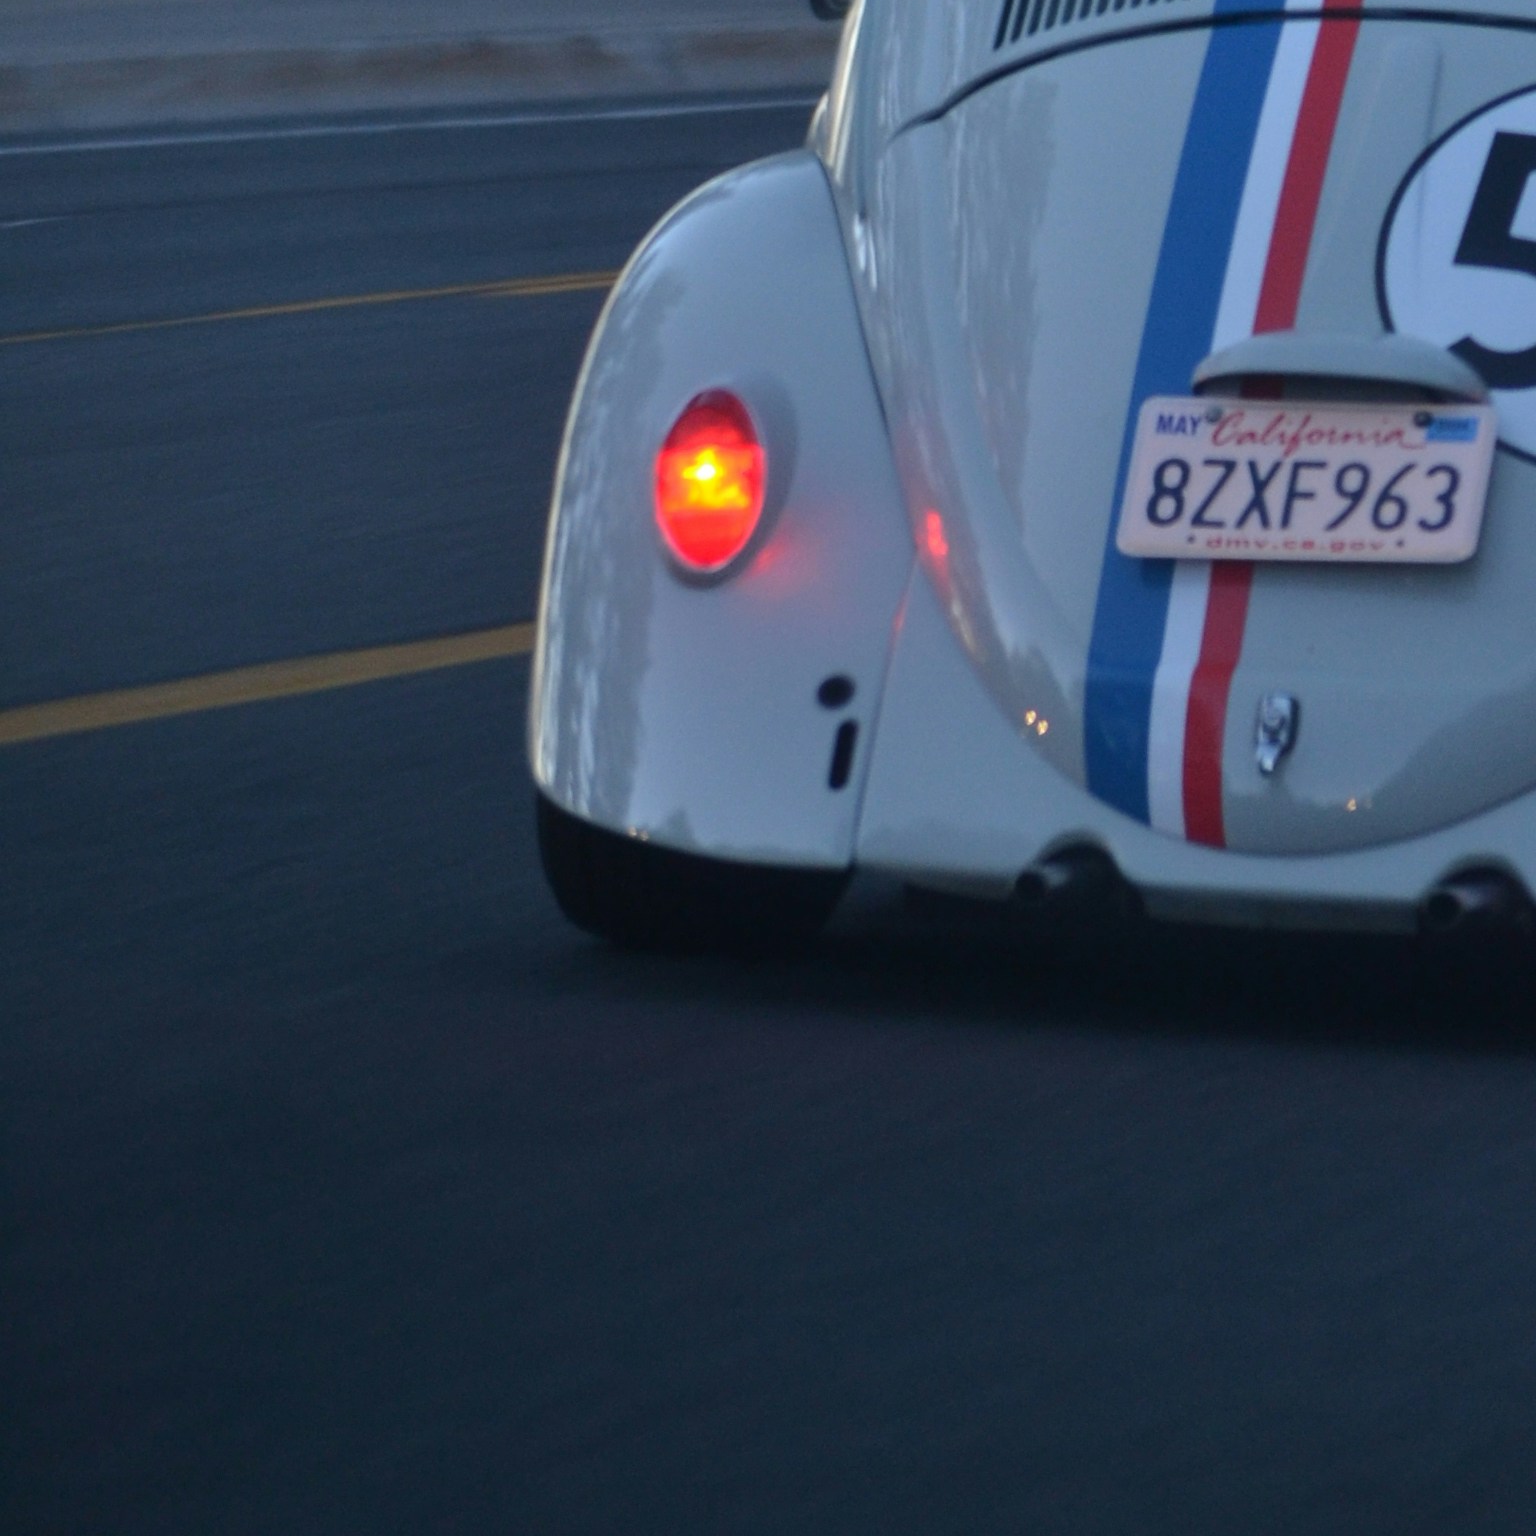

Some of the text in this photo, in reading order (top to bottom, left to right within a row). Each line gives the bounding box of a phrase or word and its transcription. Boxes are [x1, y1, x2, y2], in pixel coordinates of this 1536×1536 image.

[1156, 413, 1201, 435] MAY
[1211, 411, 1426, 458] California
[1146, 458, 1461, 532] 8ZXF963
[1206, 534, 1385, 552] dmv.ca.gov
